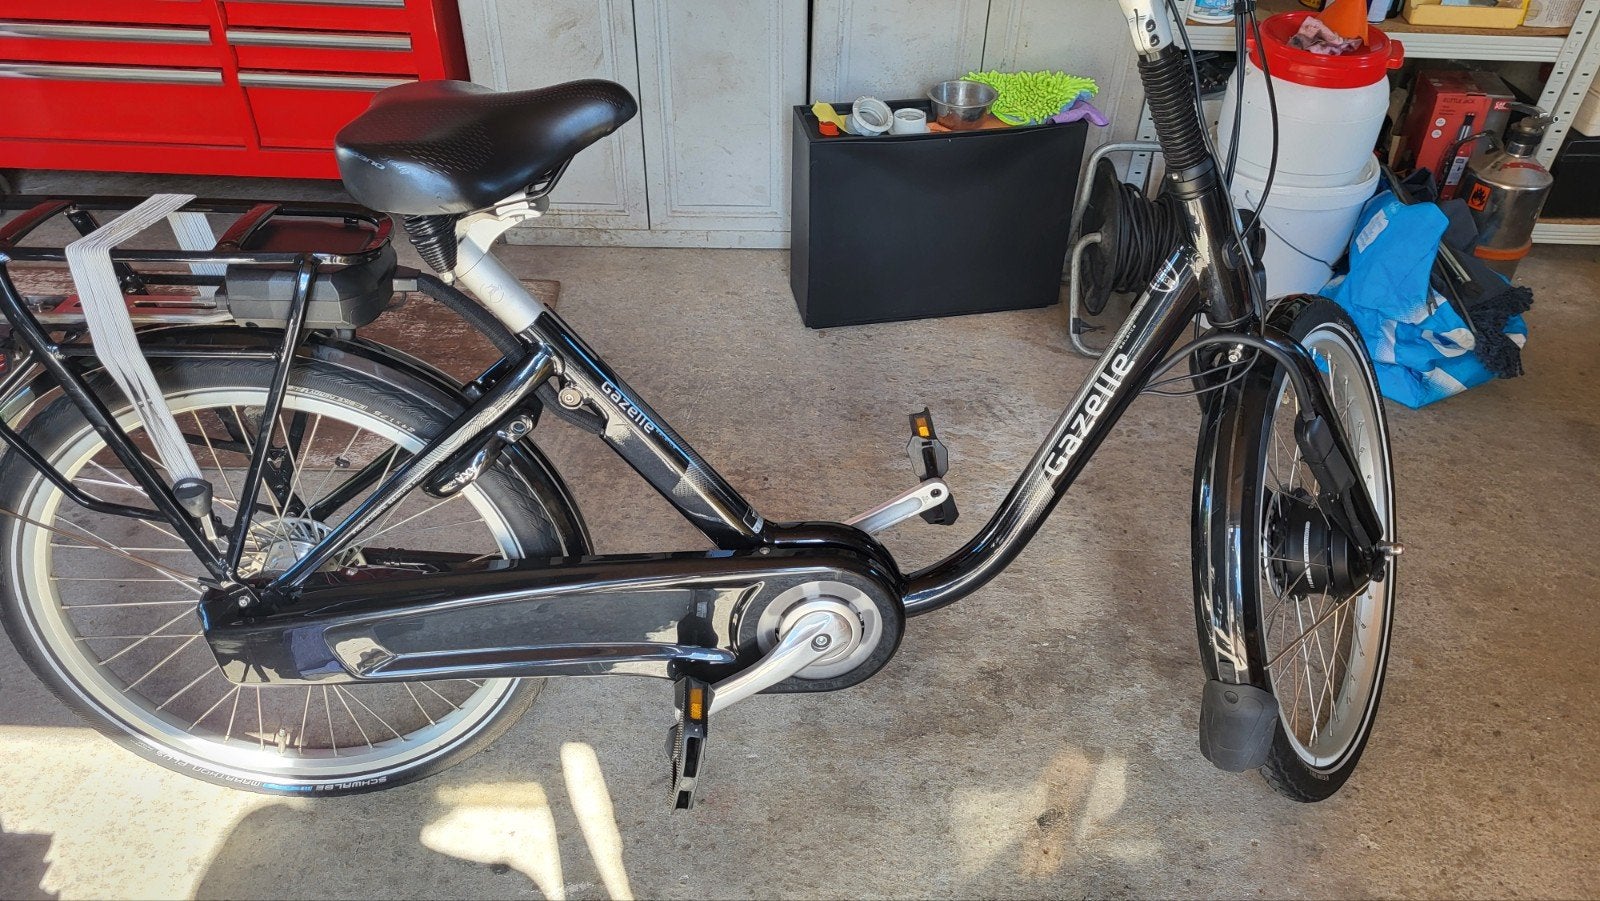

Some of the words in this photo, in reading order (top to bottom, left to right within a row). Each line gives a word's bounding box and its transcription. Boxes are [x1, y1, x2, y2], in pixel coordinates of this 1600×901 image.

[601, 381, 655, 434] Gazelle
[1044, 352, 1136, 476] Gazelle
[156, 751, 188, 767] PLUS
[193, 766, 260, 786] MARATHON
[316, 776, 387, 791] SCHWALBE
